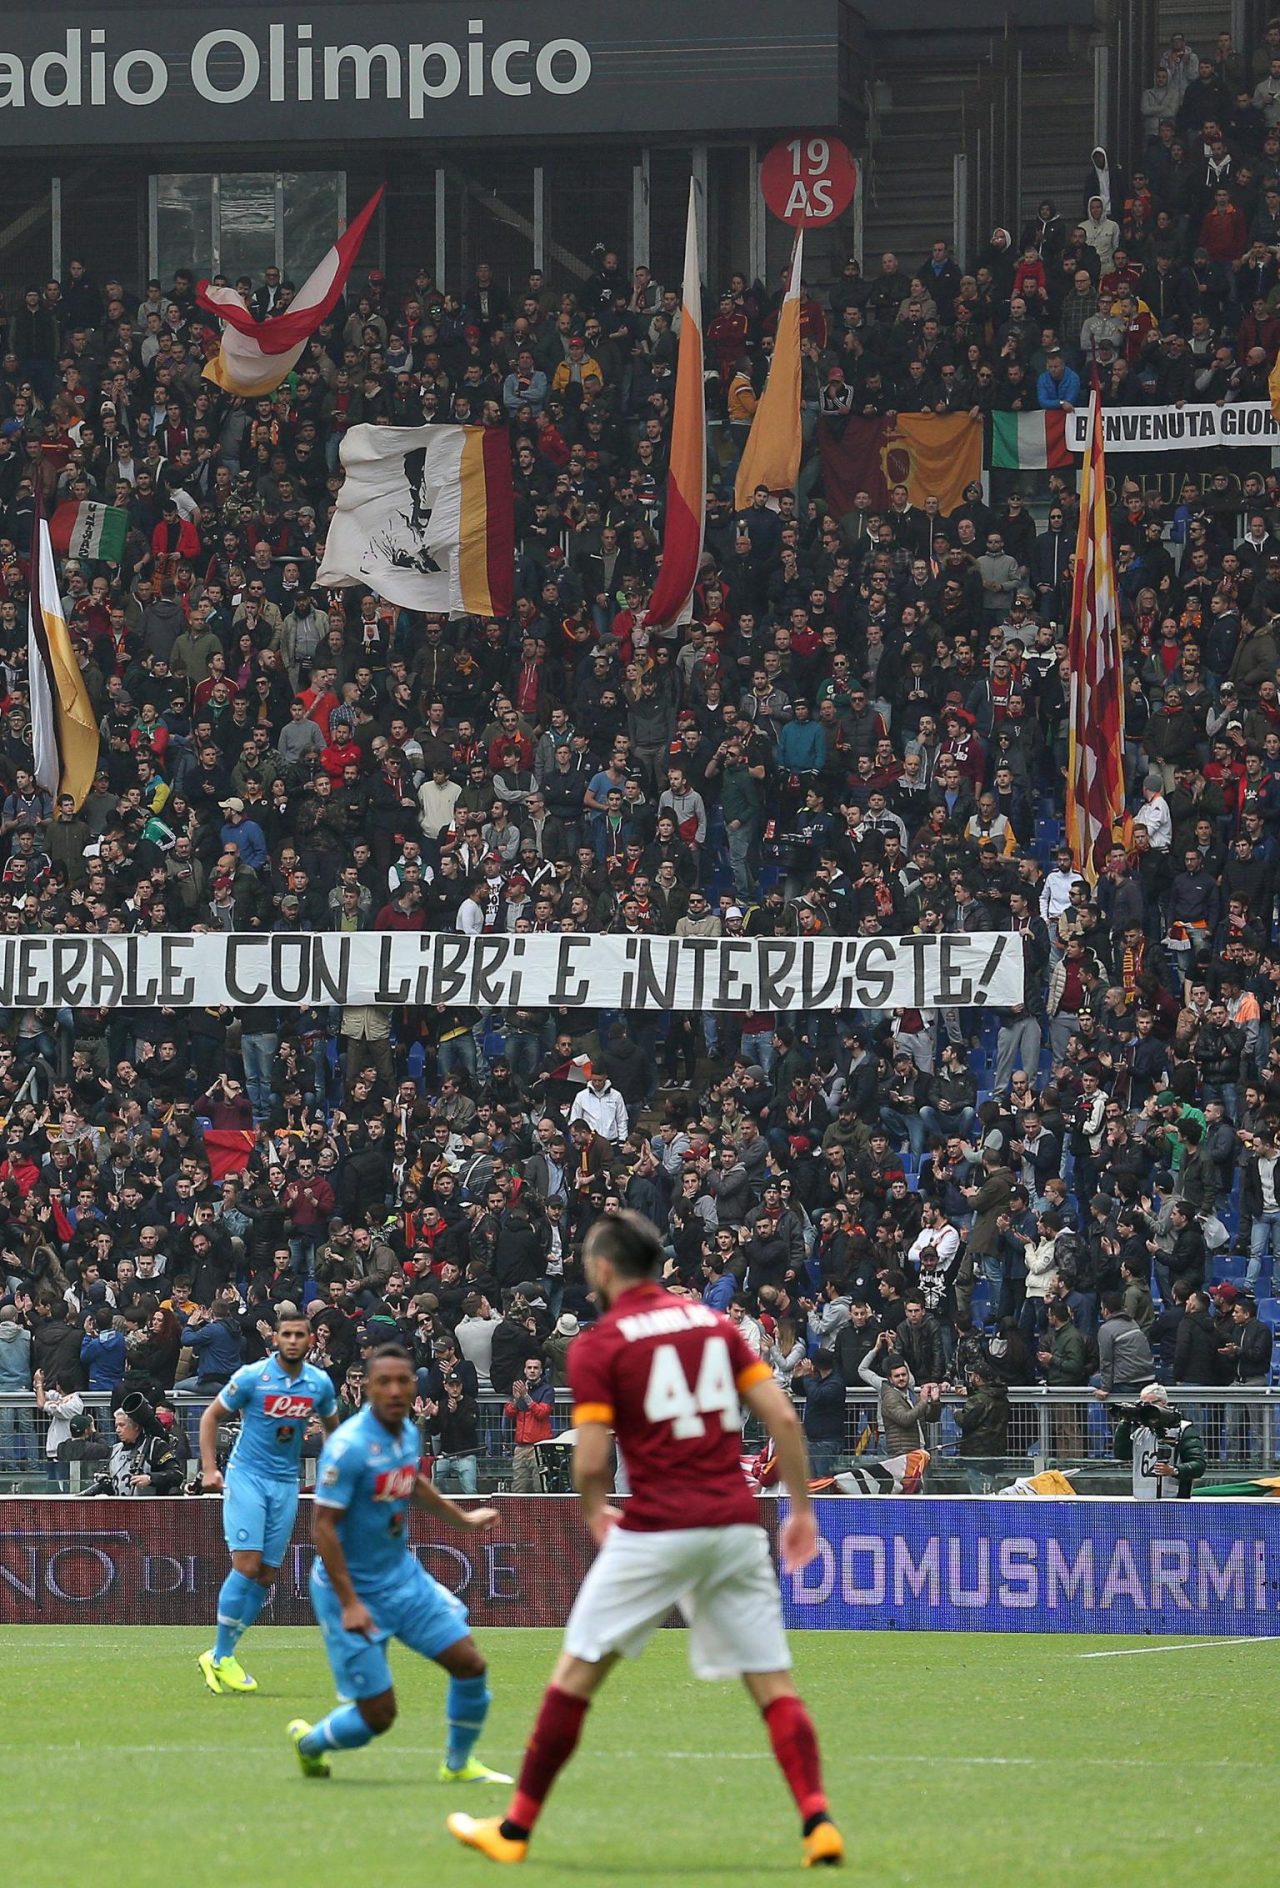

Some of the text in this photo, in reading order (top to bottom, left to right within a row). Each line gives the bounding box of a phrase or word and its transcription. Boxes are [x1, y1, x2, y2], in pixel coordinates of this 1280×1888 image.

[190, 18, 592, 119] Olimpico
[786, 138, 830, 176] 19
[783, 179, 834, 217] AS
[1075, 410, 1216, 442] BNVENUTA
[224, 934, 349, 1006] CON
[556, 935, 592, 1005] E
[644, 1336, 741, 1439] 44
[143, 1555, 198, 1593] DI
